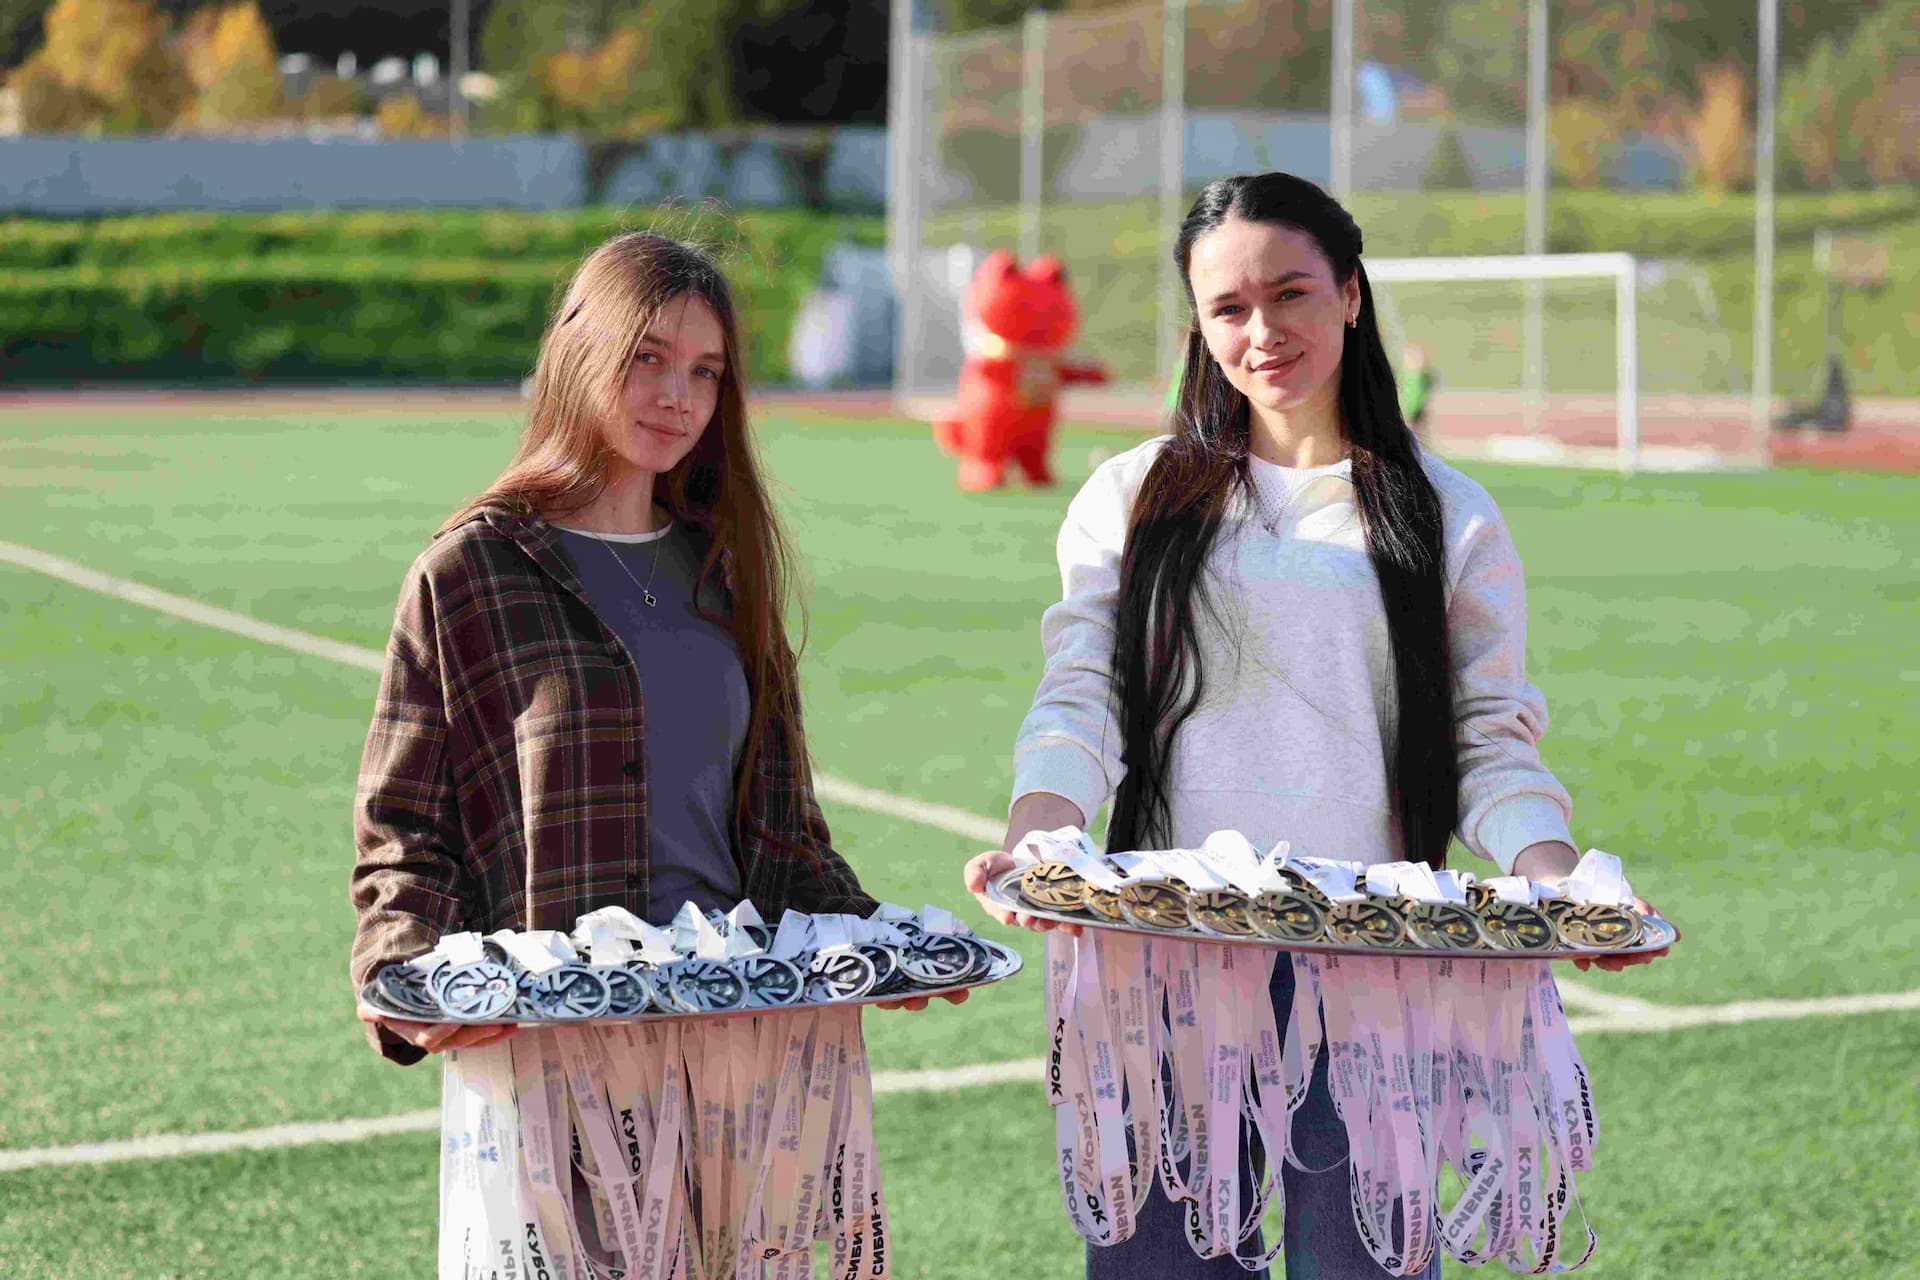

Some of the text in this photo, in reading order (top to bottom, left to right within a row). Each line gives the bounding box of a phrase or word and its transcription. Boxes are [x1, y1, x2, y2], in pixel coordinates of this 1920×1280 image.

[1051, 1017, 1065, 1097] КУБОК
[620, 1108, 641, 1173] КУБО
[1160, 1109, 1180, 1191] КУБОК
[832, 1144, 846, 1224] КУБОК
